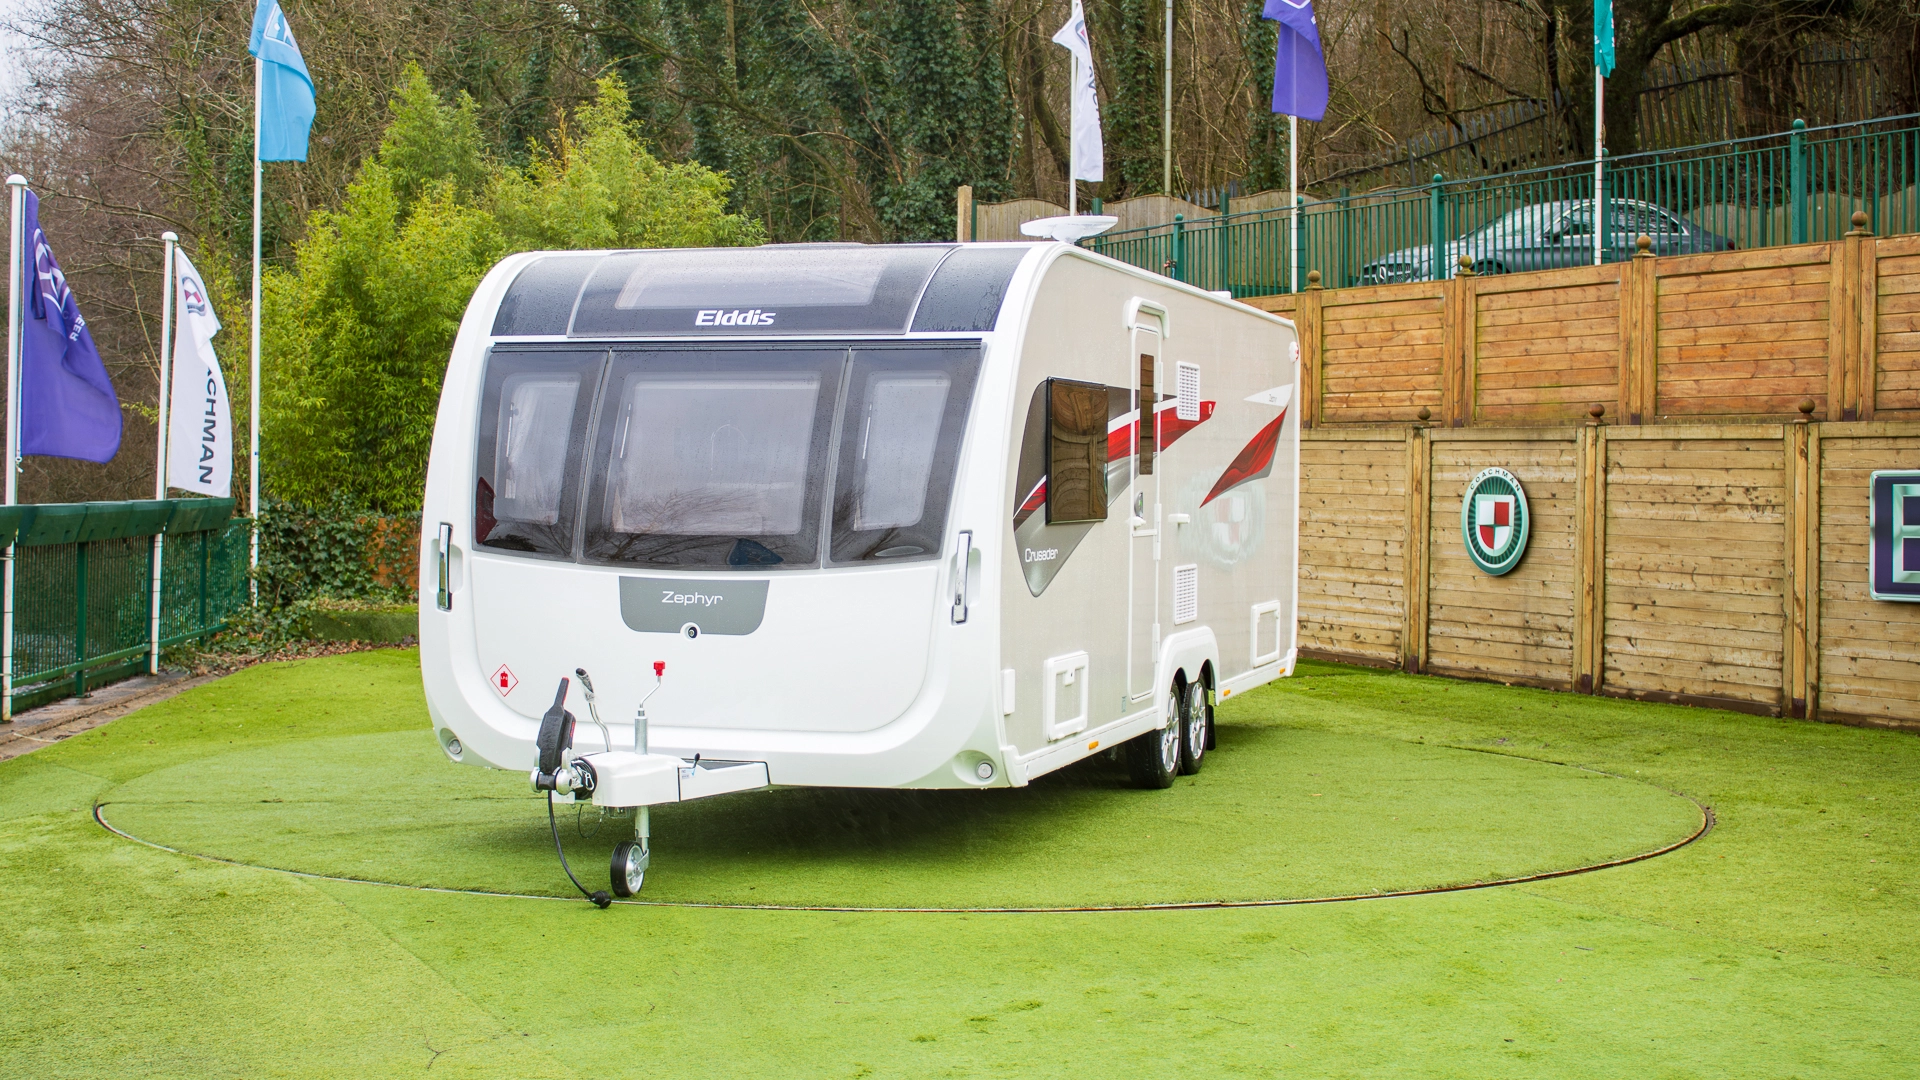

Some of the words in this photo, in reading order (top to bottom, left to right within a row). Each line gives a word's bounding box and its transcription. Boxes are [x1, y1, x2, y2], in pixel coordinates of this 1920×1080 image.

[695, 309, 776, 326] Elddis
[1470, 468, 1521, 492] COACHMAN
[1024, 547, 1059, 563] Crusader
[661, 590, 723, 607] Zephyr
